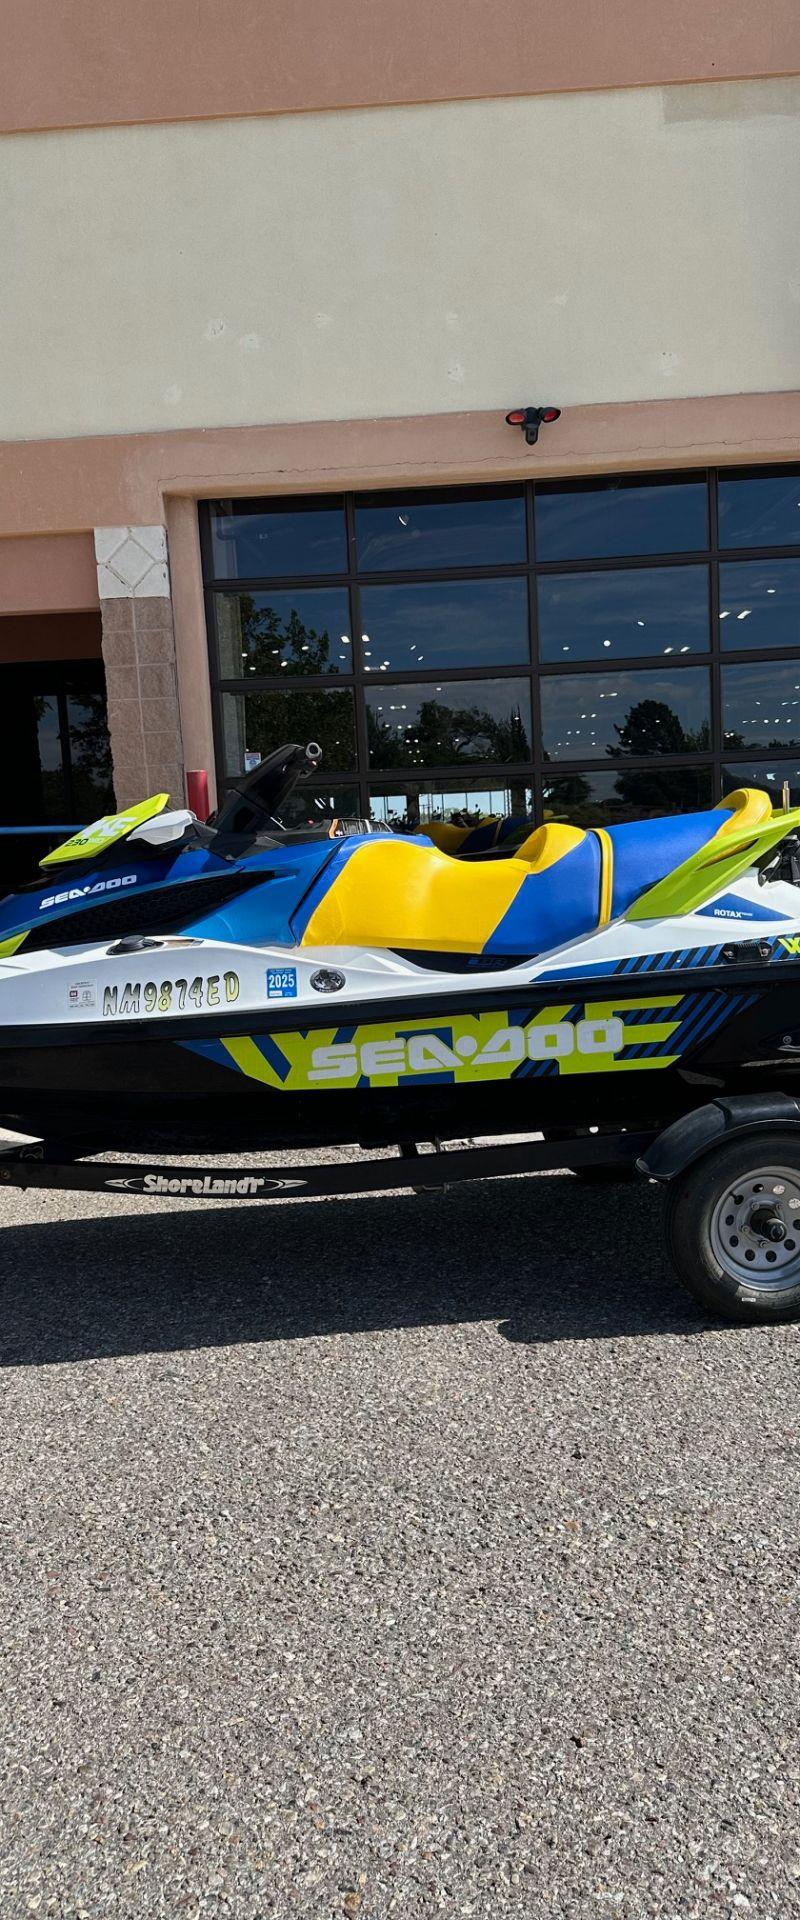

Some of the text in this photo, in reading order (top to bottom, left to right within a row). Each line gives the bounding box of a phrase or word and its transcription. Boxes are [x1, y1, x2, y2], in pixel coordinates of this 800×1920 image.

[713, 908, 742, 918] ROTAX
[269, 973, 295, 988] 2025
[103, 971, 240, 1016] NM9874ED
